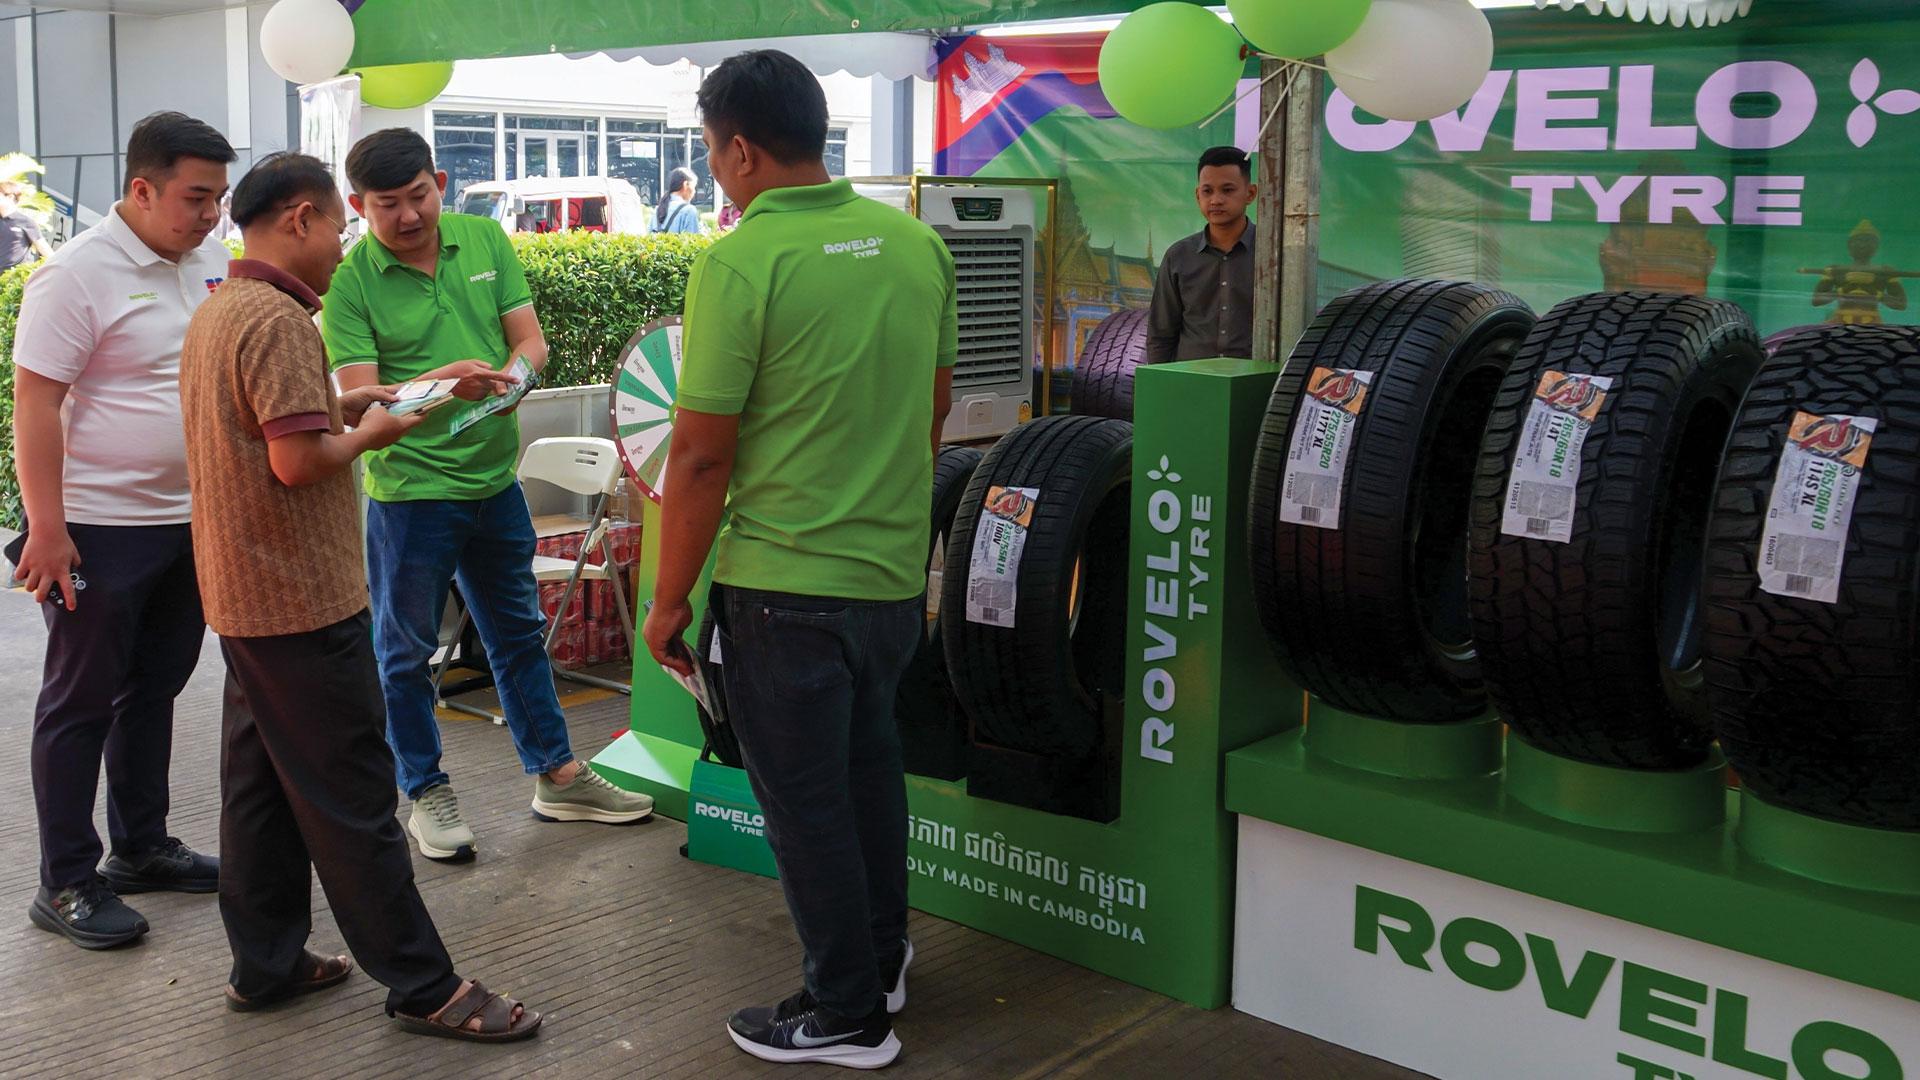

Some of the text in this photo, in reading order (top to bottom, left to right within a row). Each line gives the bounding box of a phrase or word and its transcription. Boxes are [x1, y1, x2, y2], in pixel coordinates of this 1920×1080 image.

[1511, 175, 1805, 226] TYRE
[823, 237, 877, 255] ROVELO
[853, 248, 880, 259] TYRE
[1312, 410, 1331, 449] 117T XL
[1319, 410, 1342, 470] 275/55R20
[1547, 415, 1564, 442] 114T
[1550, 415, 1577, 478] 265/65R18
[1800, 460, 1825, 506] 114S XL
[1811, 462, 1839, 531] 265/60R18
[993, 522, 1004, 546] 100V
[1187, 494, 1212, 621] TYRE
[1140, 489, 1182, 764] ROVELO
[695, 801, 765, 828] ROVELO
[731, 823, 764, 837] TYRE
[964, 831, 1070, 886] ផលិតផល
[1079, 866, 1147, 916] កម្ពុជា
[943, 867, 999, 898] MADE
[1004, 886, 1024, 907] IN
[1028, 894, 1147, 945] CAMBODIA
[1354, 884, 1905, 1080] ROVELO
